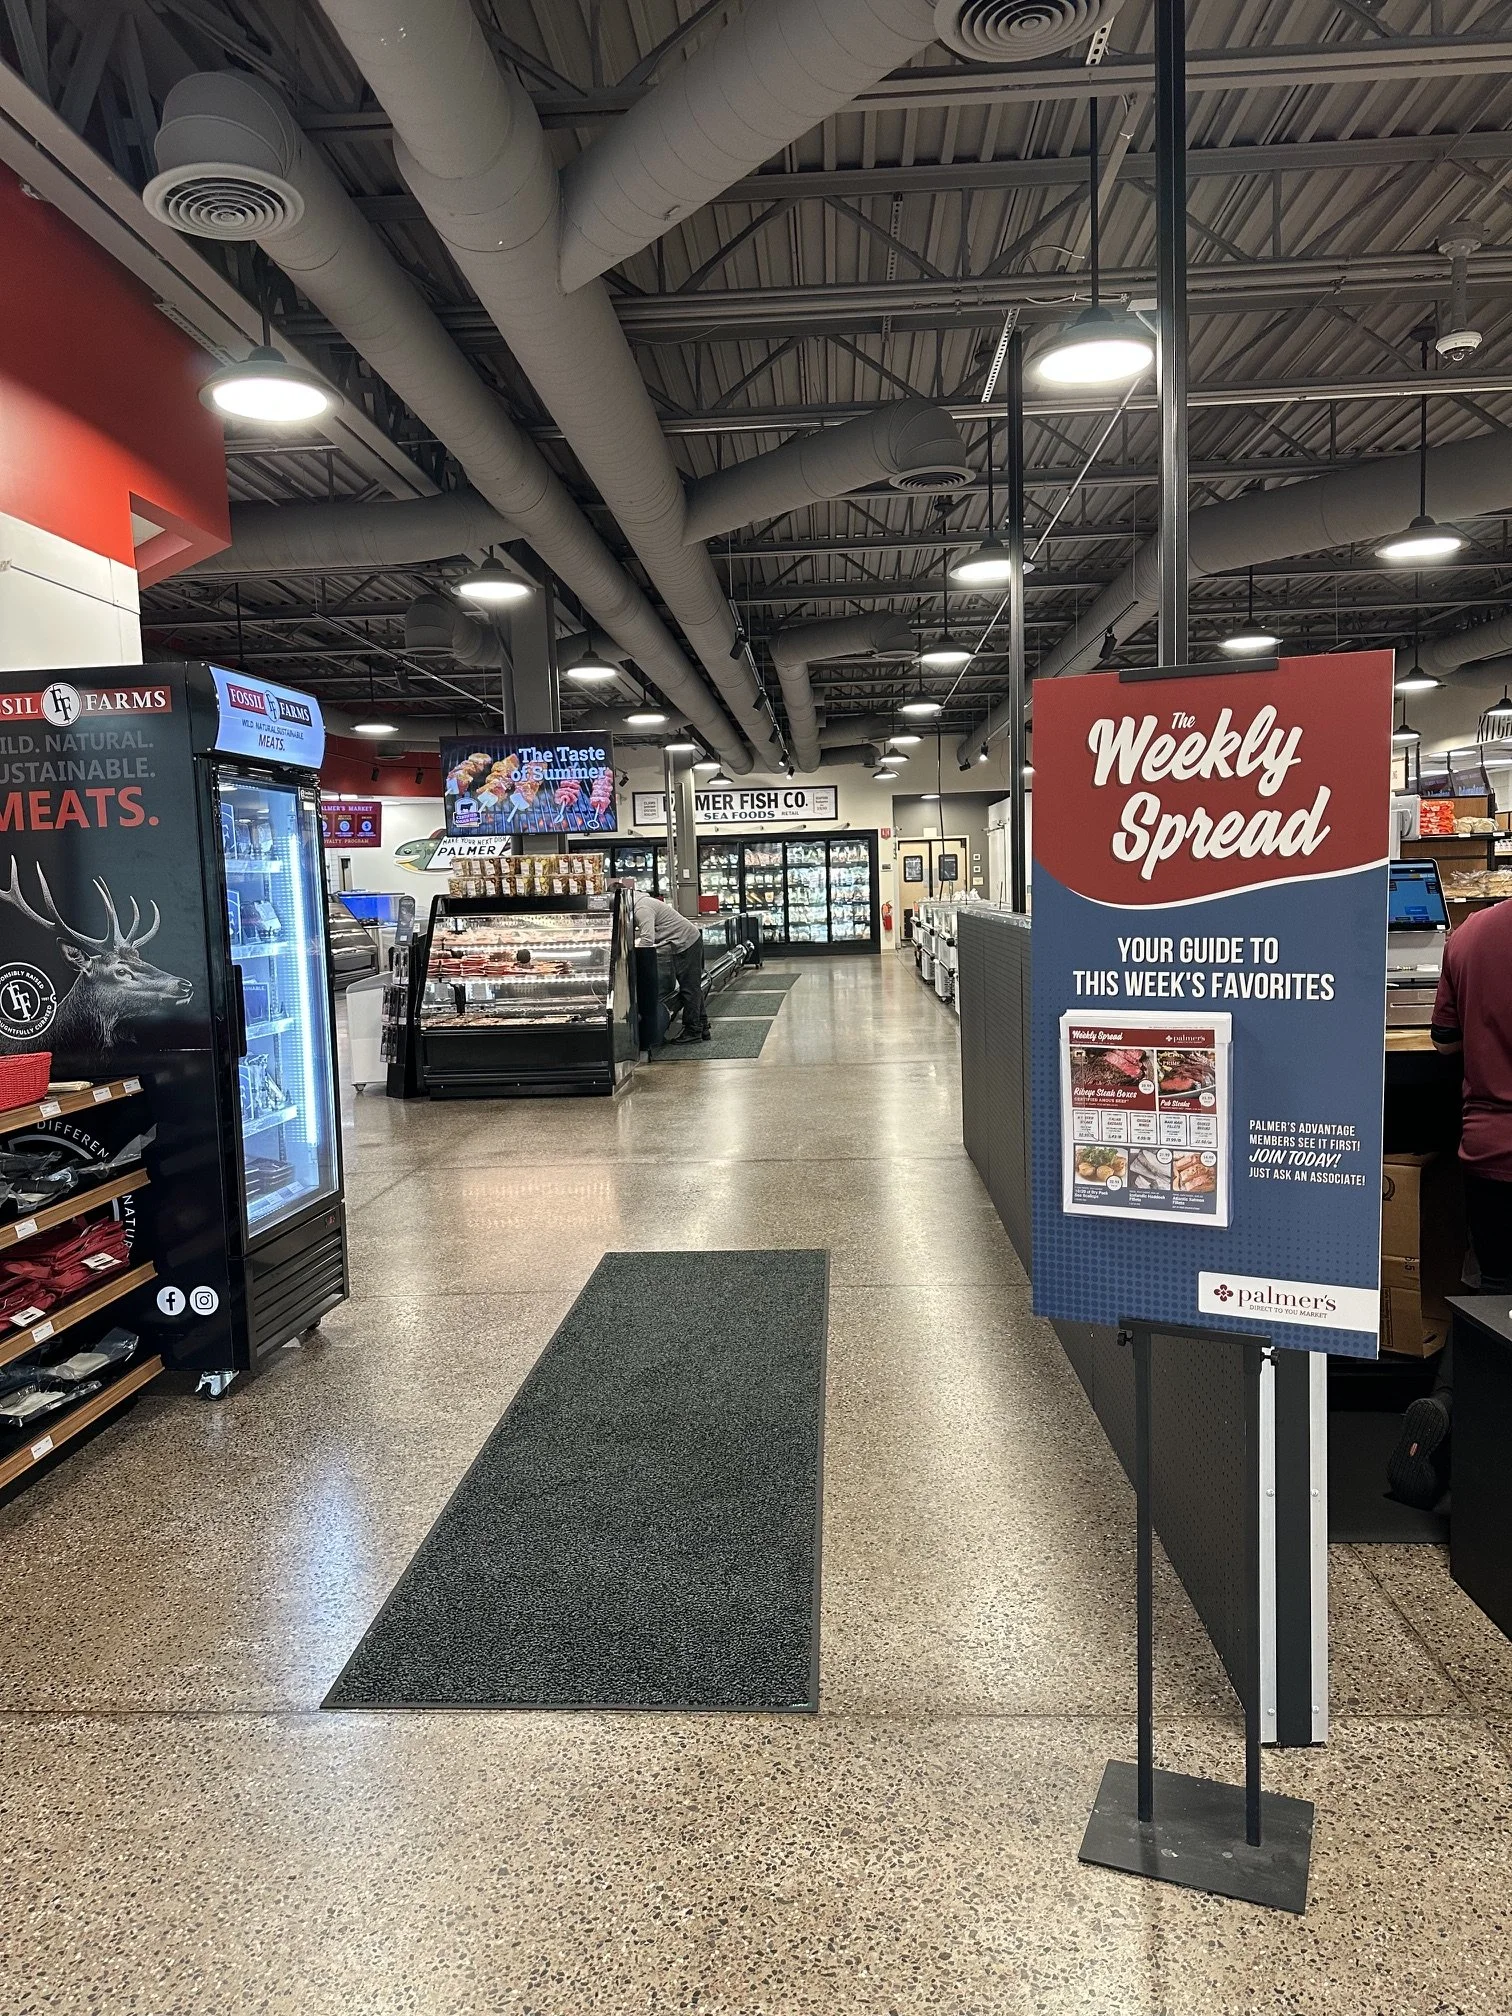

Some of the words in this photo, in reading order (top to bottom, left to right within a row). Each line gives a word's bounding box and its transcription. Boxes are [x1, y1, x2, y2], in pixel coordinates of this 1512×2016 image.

[0, 697, 38, 715] SIL
[85, 690, 166, 711] FARMS
[230, 688, 264, 710] FOSSIL
[280, 701, 310, 722] FARMS
[1171, 712, 1196, 730] The
[46, 730, 154, 753] NATURAL.
[258, 734, 285, 752] MEATS.
[1088, 704, 1303, 797] Weekly
[518, 747, 554, 763] The
[556, 746, 605, 762] Taste
[510, 768, 531, 782] of
[533, 765, 607, 781] Summer
[0, 786, 160, 832] MEATS.
[662, 793, 734, 811] PMER
[740, 792, 779, 809] FISH
[783, 791, 808, 809] CO.
[704, 812, 728, 820] SEA
[732, 810, 775, 819] FOODS
[461, 837, 477, 845] YOUR
[477, 837, 494, 845] NEXT
[1112, 784, 1331, 881] Spread
[437, 846, 496, 856] PALMER
[1117, 938, 1174, 963] YOUR
[1179, 937, 1244, 963] GUIDE
[1250, 938, 1279, 963] TO
[26, 972, 44, 989] RAISED
[1073, 971, 1119, 995] THIS
[1124, 972, 1205, 998] WEEK'S
[1211, 973, 1335, 1001] FAVORITES
[0, 1020, 34, 1035] UGHTFULLY
[35, 1005, 52, 1030] CURATED
[1072, 1030, 1097, 1042] Weekly
[1098, 1031, 1123, 1042] Spread
[1173, 1034, 1205, 1043] palmer's
[1073, 1087, 1095, 1098] Ribeye
[1096, 1088, 1115, 1098] Steak
[1116, 1090, 1137, 1098] Boxes
[1249, 1119, 1296, 1134] PALMER'S
[1298, 1122, 1355, 1137] ADVANTAGE
[1250, 1133, 1296, 1148] MEMBERS
[1298, 1136, 1316, 1149] SEE
[1318, 1137, 1328, 1149] IT
[1330, 1138, 1361, 1152] FIRST!
[1249, 1148, 1284, 1166] JOIN
[1287, 1151, 1342, 1169] TODAY!
[1249, 1166, 1270, 1179] JUST
[1273, 1168, 1292, 1181] ASK
[1294, 1170, 1307, 1182] AN
[1310, 1171, 1366, 1186] ASSOCIATE!
[122, 1195, 136, 1256] NATUR
[1238, 1284, 1337, 1312] palmer's
[1249, 1304, 1271, 1312] DIRECT
[1282, 1307, 1298, 1315] YOU
[1299, 1309, 1328, 1319] MARKET
